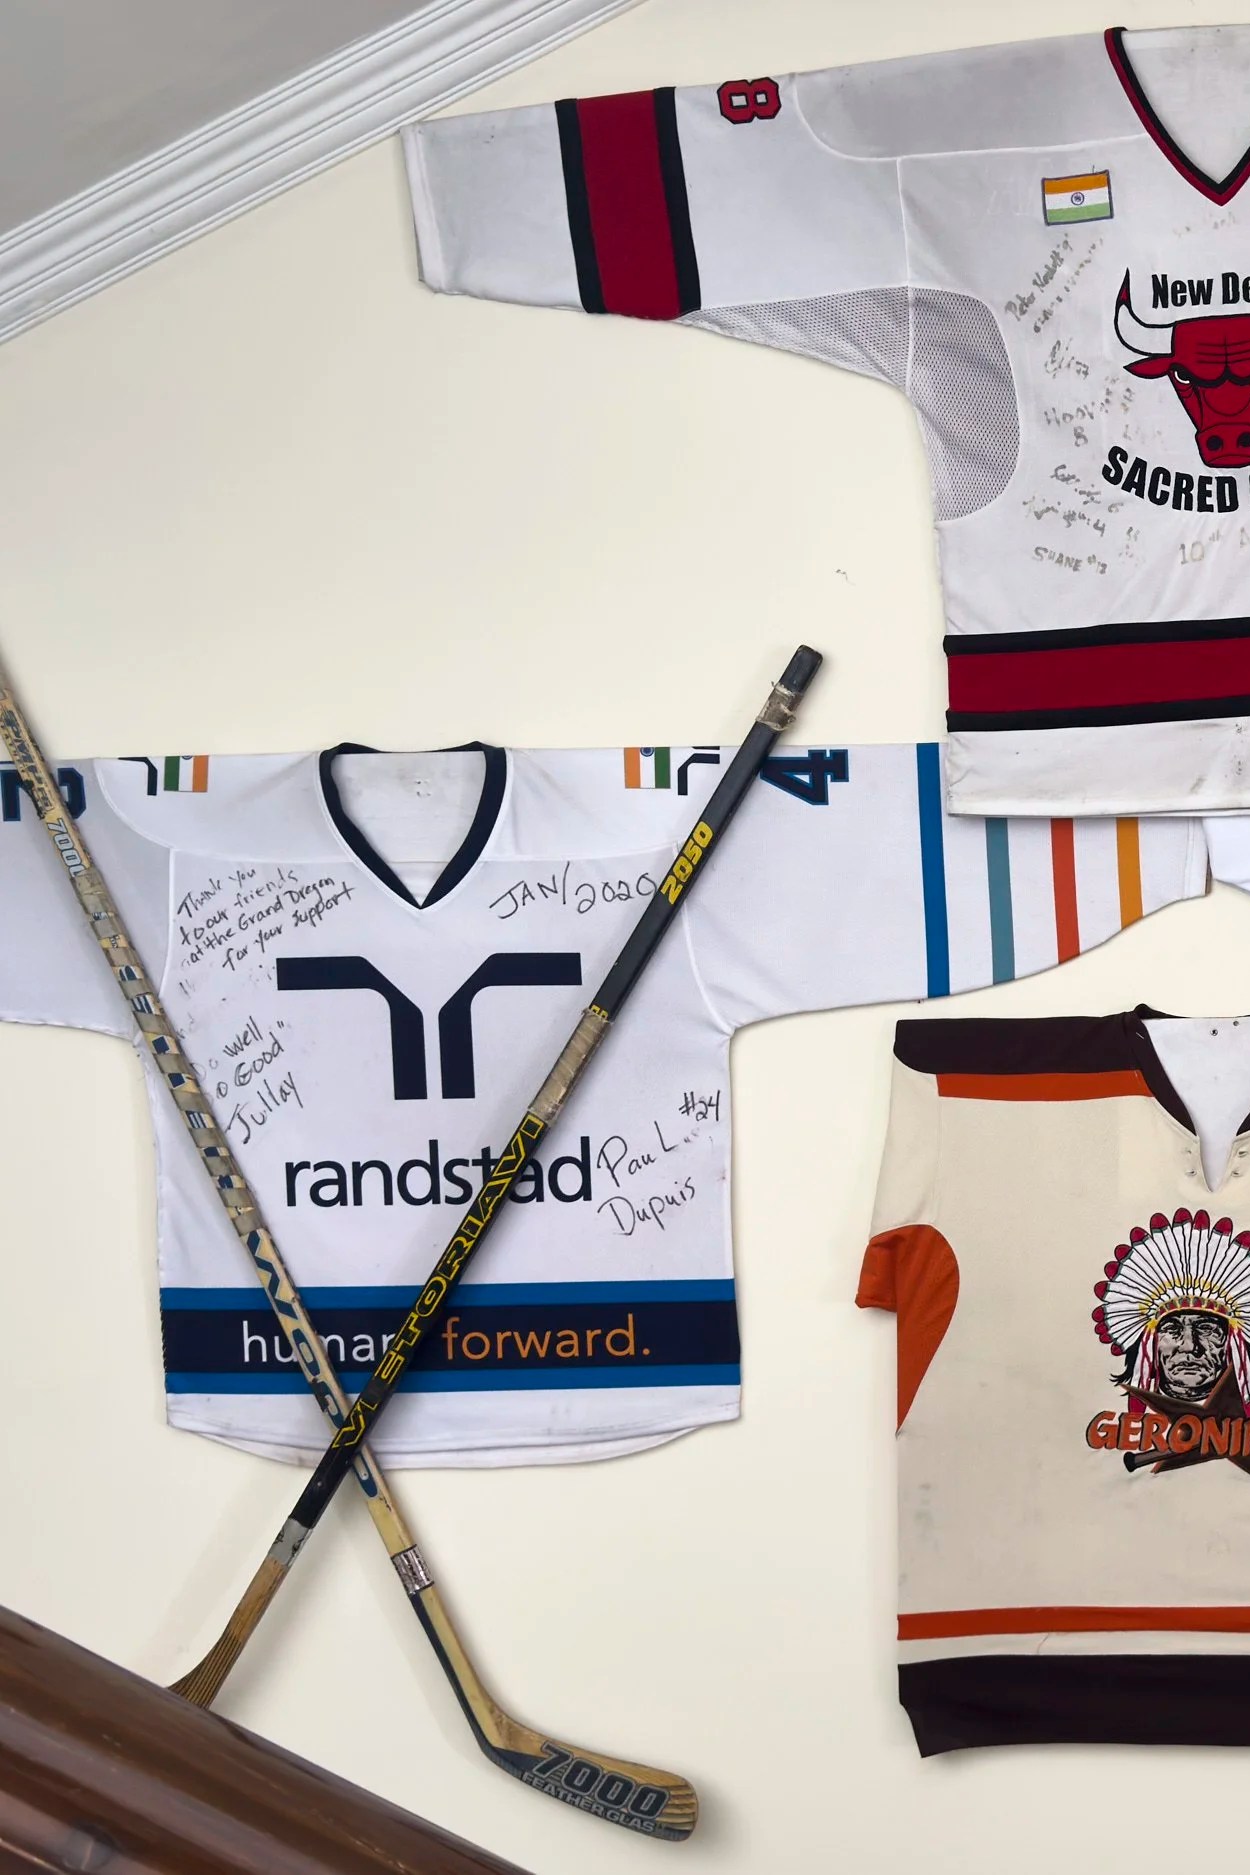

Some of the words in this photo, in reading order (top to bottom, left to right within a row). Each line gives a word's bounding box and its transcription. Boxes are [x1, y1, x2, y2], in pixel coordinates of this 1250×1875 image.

[717, 77, 781, 124] 8
[1152, 274, 1213, 308] New
[1102, 446, 1239, 513] SACRED
[759, 749, 850, 806] 4
[233, 867, 298, 908] friends
[660, 822, 714, 904] 2050
[238, 895, 284, 931] Grand
[286, 1136, 592, 1209] randstad
[598, 1177, 695, 1235] Dupuis
[441, 1314, 651, 1361] forward.
[522, 1769, 604, 1820] FEATHER
[529, 1740, 671, 1820] 7000
